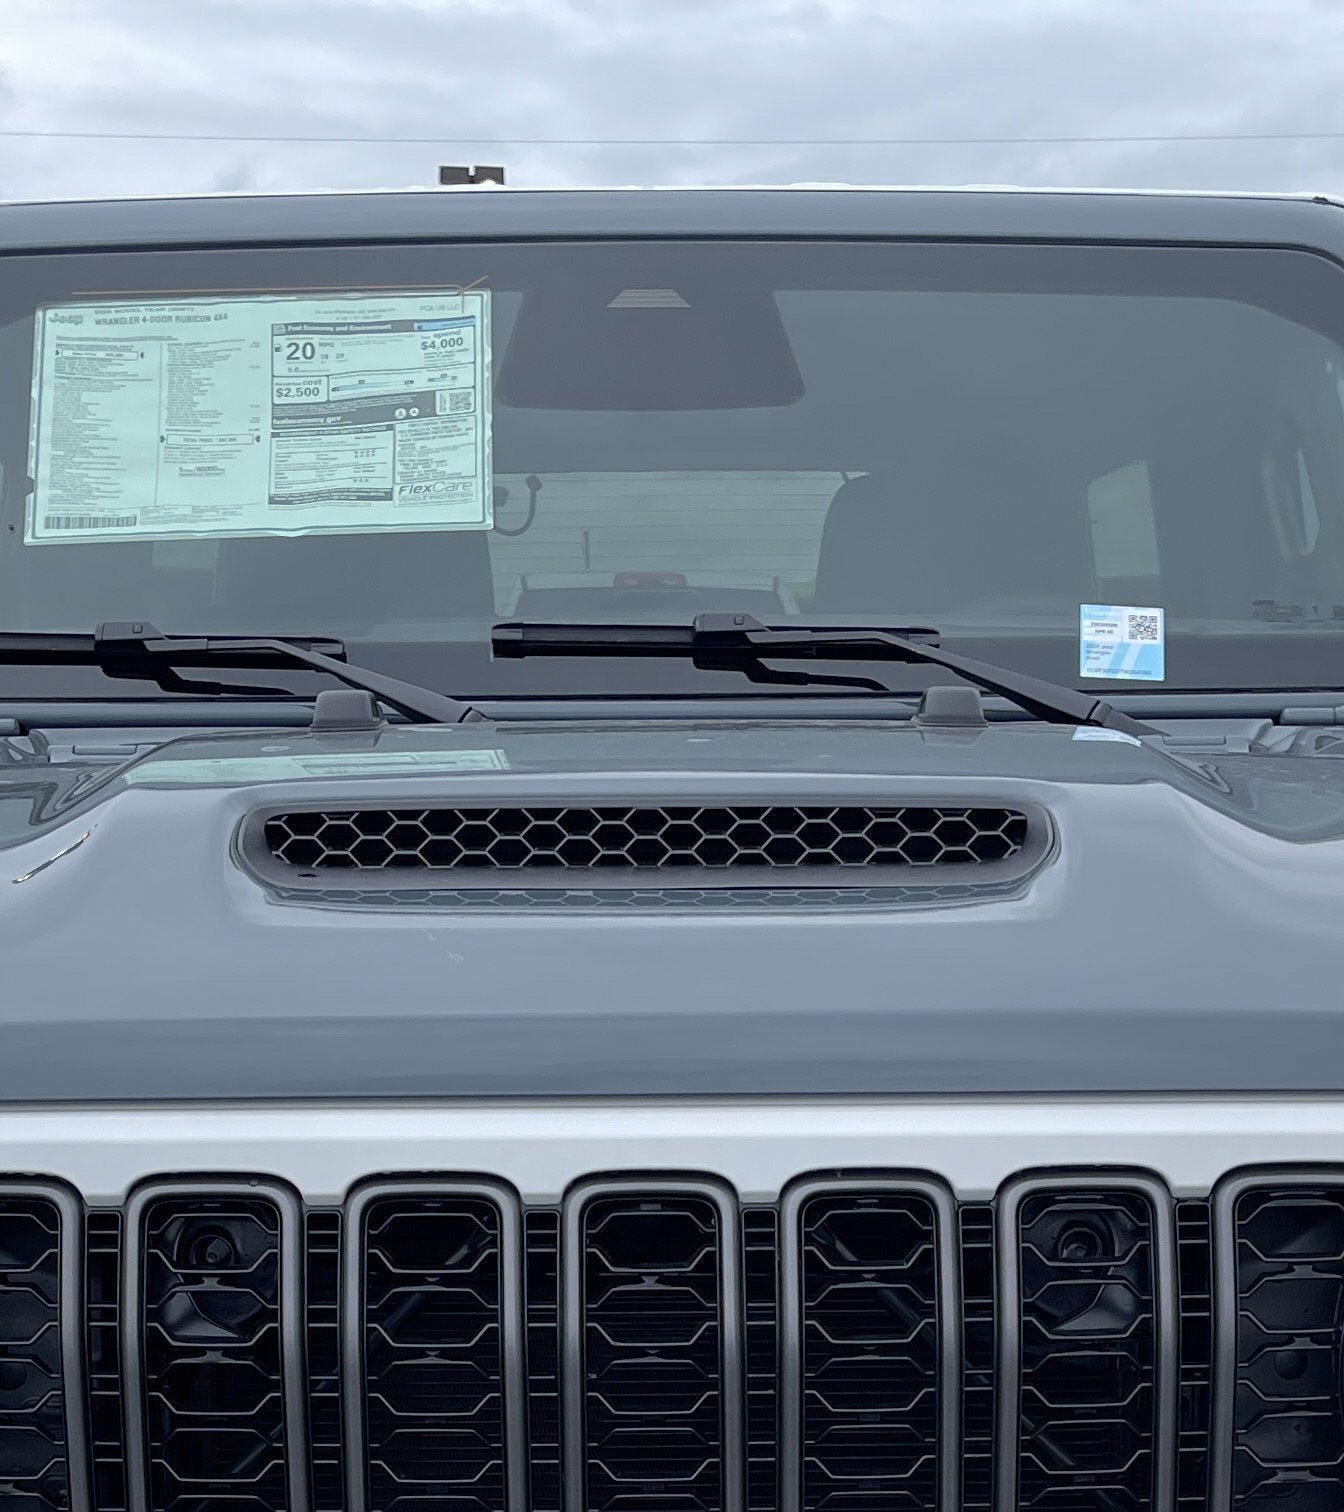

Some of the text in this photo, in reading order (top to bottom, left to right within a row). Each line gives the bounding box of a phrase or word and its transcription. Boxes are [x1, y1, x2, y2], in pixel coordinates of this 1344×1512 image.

[48, 312, 84, 326] Jeep
[95, 312, 229, 326] WRANGLER 4-DOOR RUBICON 4X4
[420, 336, 464, 351] $4,000
[286, 341, 316, 361] 20
[276, 386, 321, 399] $2,500
[398, 481, 473, 496] FlexCare
